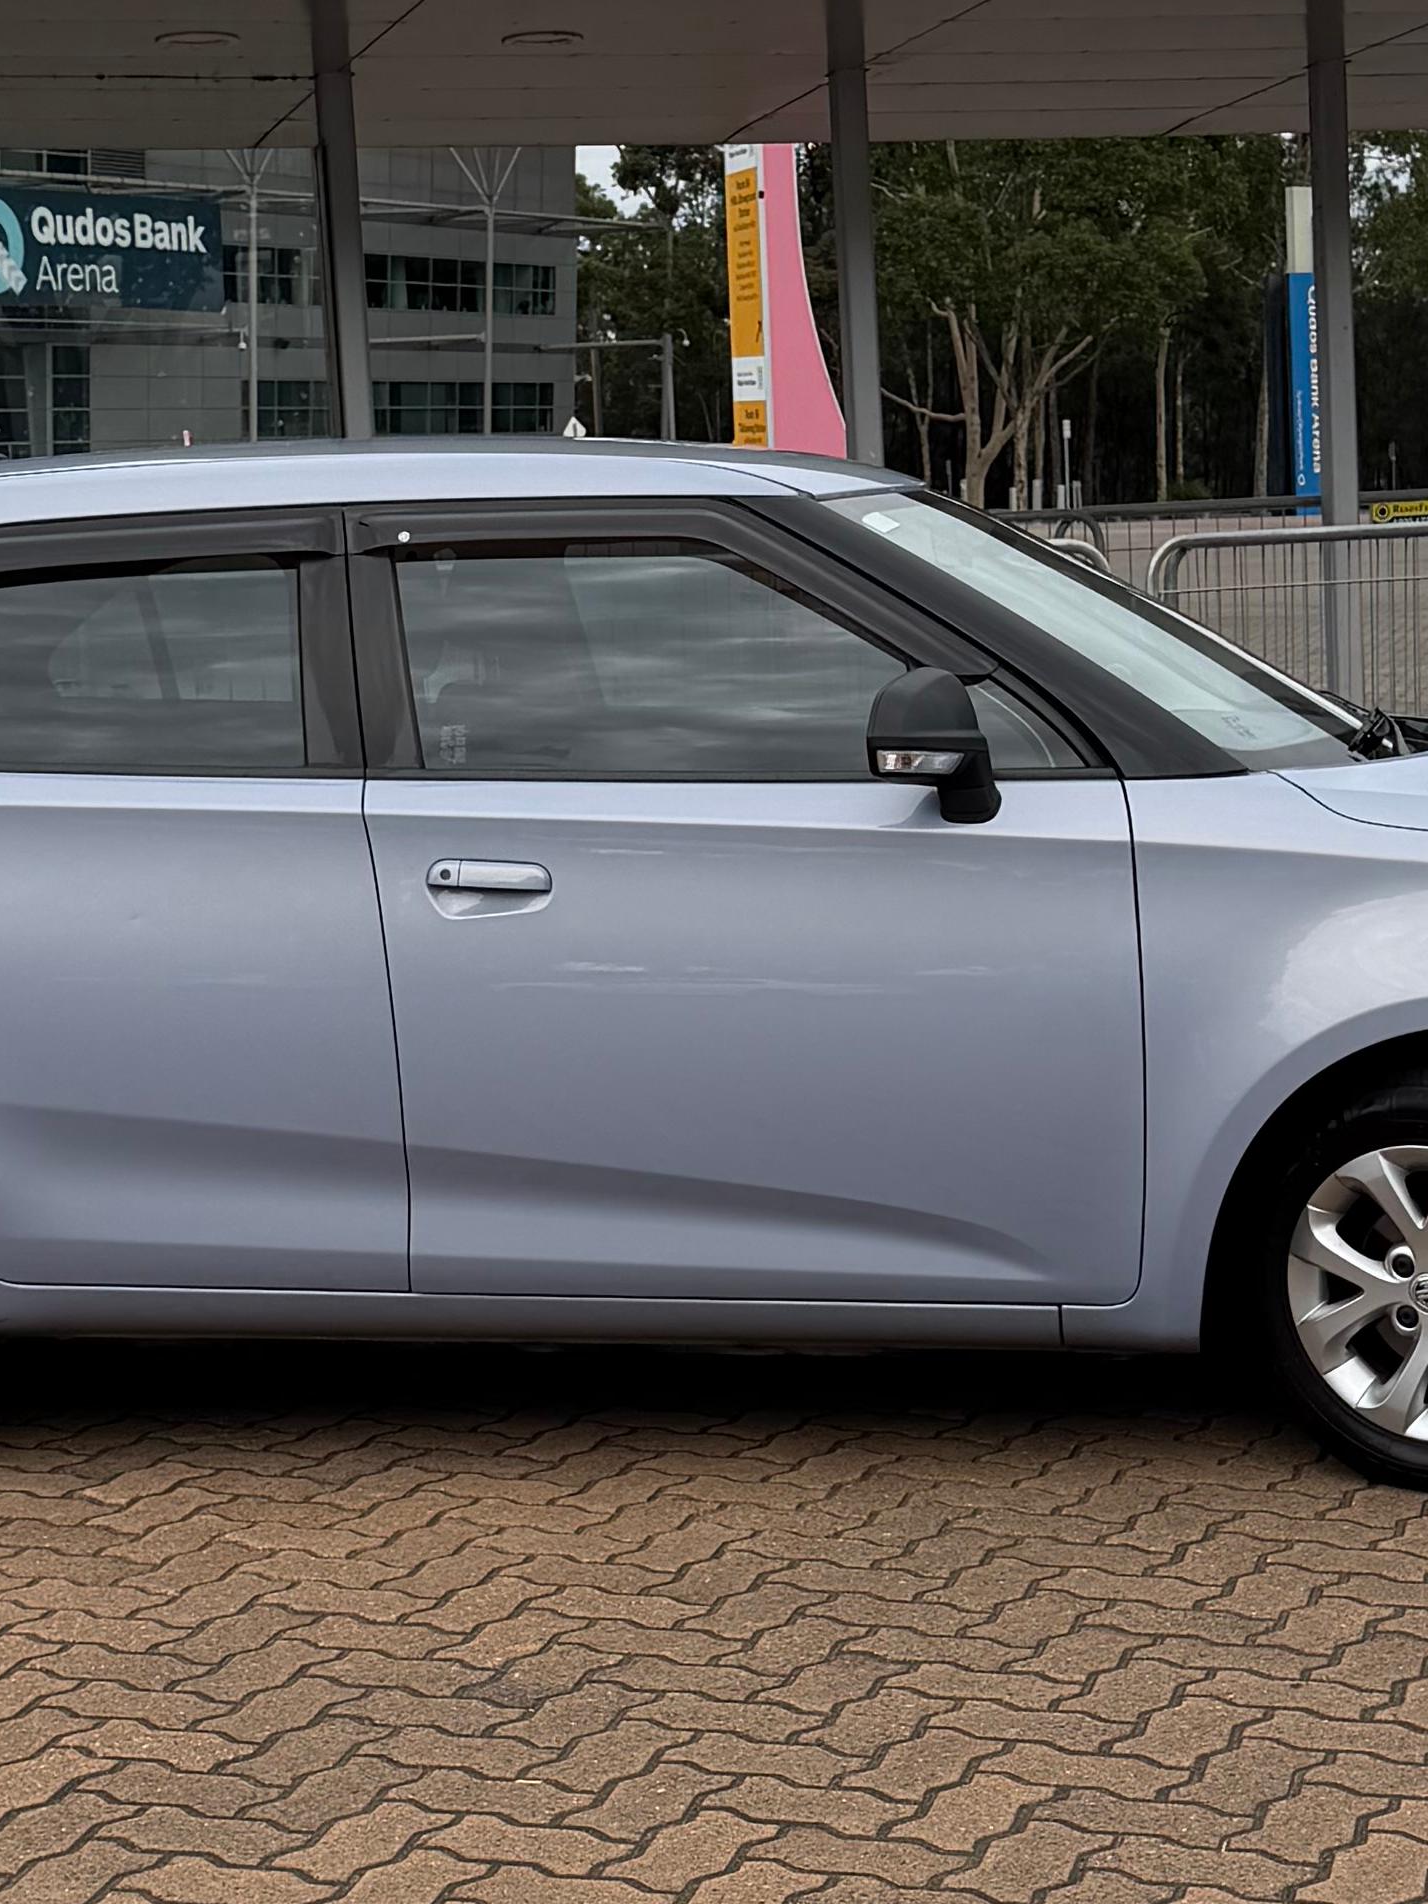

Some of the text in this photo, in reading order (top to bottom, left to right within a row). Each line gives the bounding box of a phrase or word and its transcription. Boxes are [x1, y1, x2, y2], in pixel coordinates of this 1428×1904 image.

[30, 205, 209, 254] Qudos Bank
[35, 255, 121, 294] Arena
